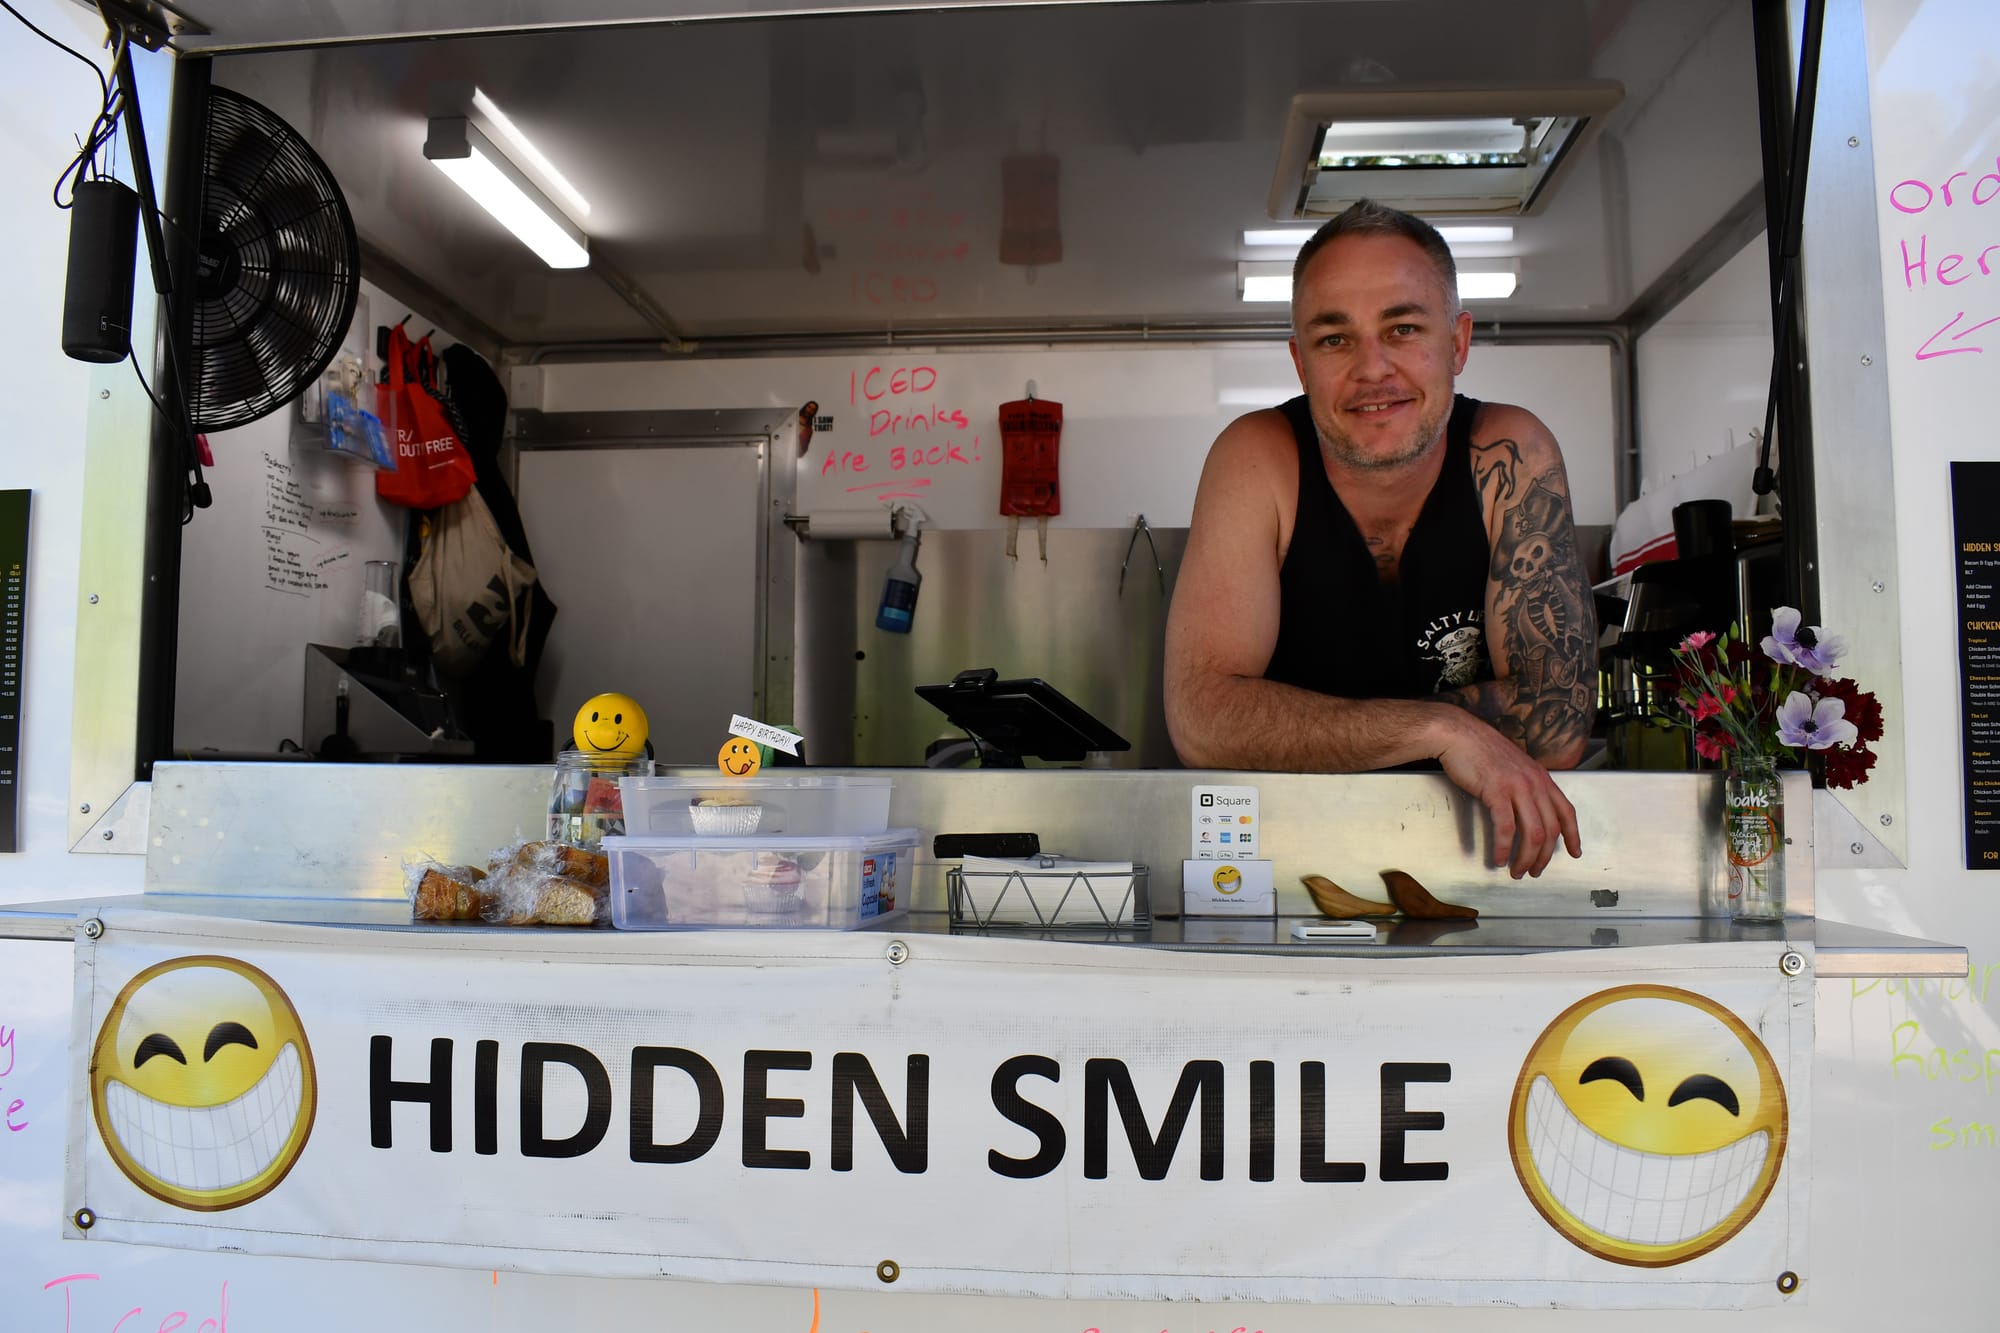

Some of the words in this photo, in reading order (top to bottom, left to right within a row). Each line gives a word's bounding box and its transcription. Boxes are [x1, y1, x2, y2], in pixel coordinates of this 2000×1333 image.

[851, 366, 937, 405] ICED
[870, 403, 968, 437] Drinks
[425, 437, 454, 455] FREE
[822, 450, 871, 476] Are
[890, 435, 982, 471] Back!
[1963, 542, 1992, 552] HIDDEN
[1417, 611, 1462, 650] SALTY
[1967, 621, 2000, 630] CHICKEN
[734, 719, 758, 736] HAPPY
[757, 727, 791, 747] BIRTHDAY!
[1216, 795, 1252, 807] Square
[370, 1034, 929, 1174] HIDDEN
[988, 1054, 1451, 1183] SMILE
